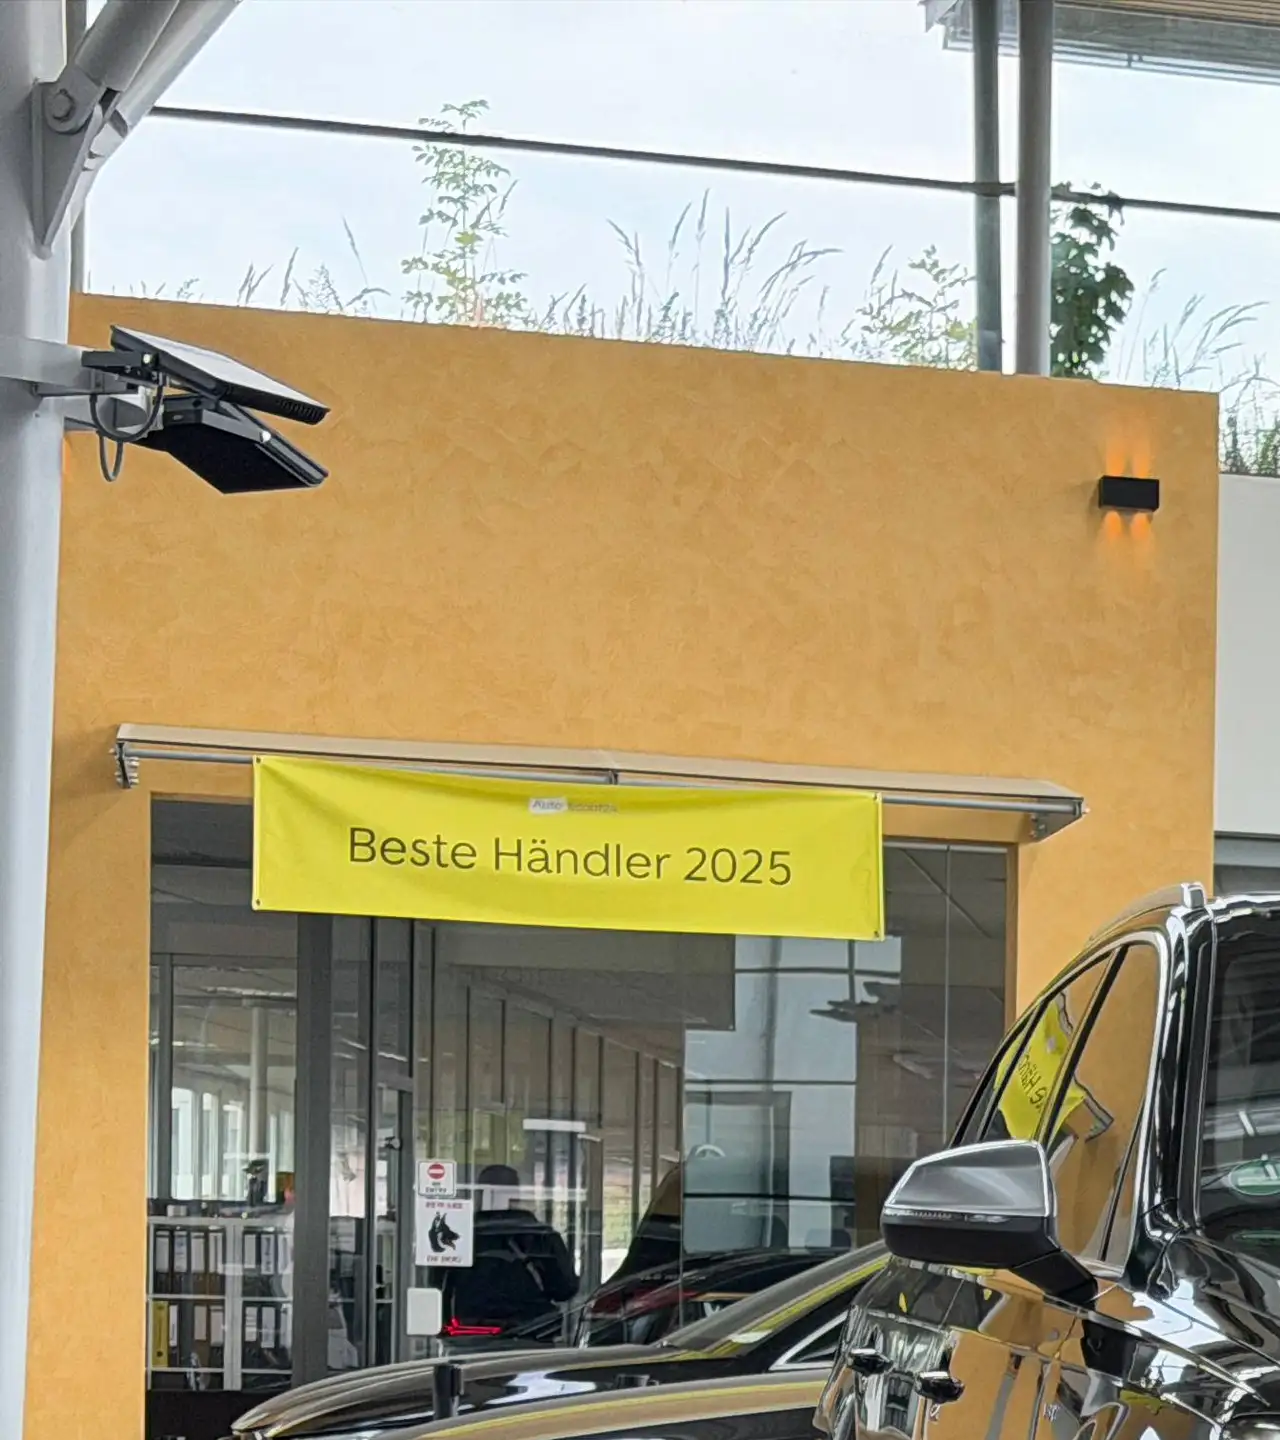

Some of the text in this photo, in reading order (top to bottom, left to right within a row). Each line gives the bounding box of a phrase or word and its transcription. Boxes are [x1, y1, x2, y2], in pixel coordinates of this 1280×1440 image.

[348, 826, 792, 886] Beste Händler 2025
